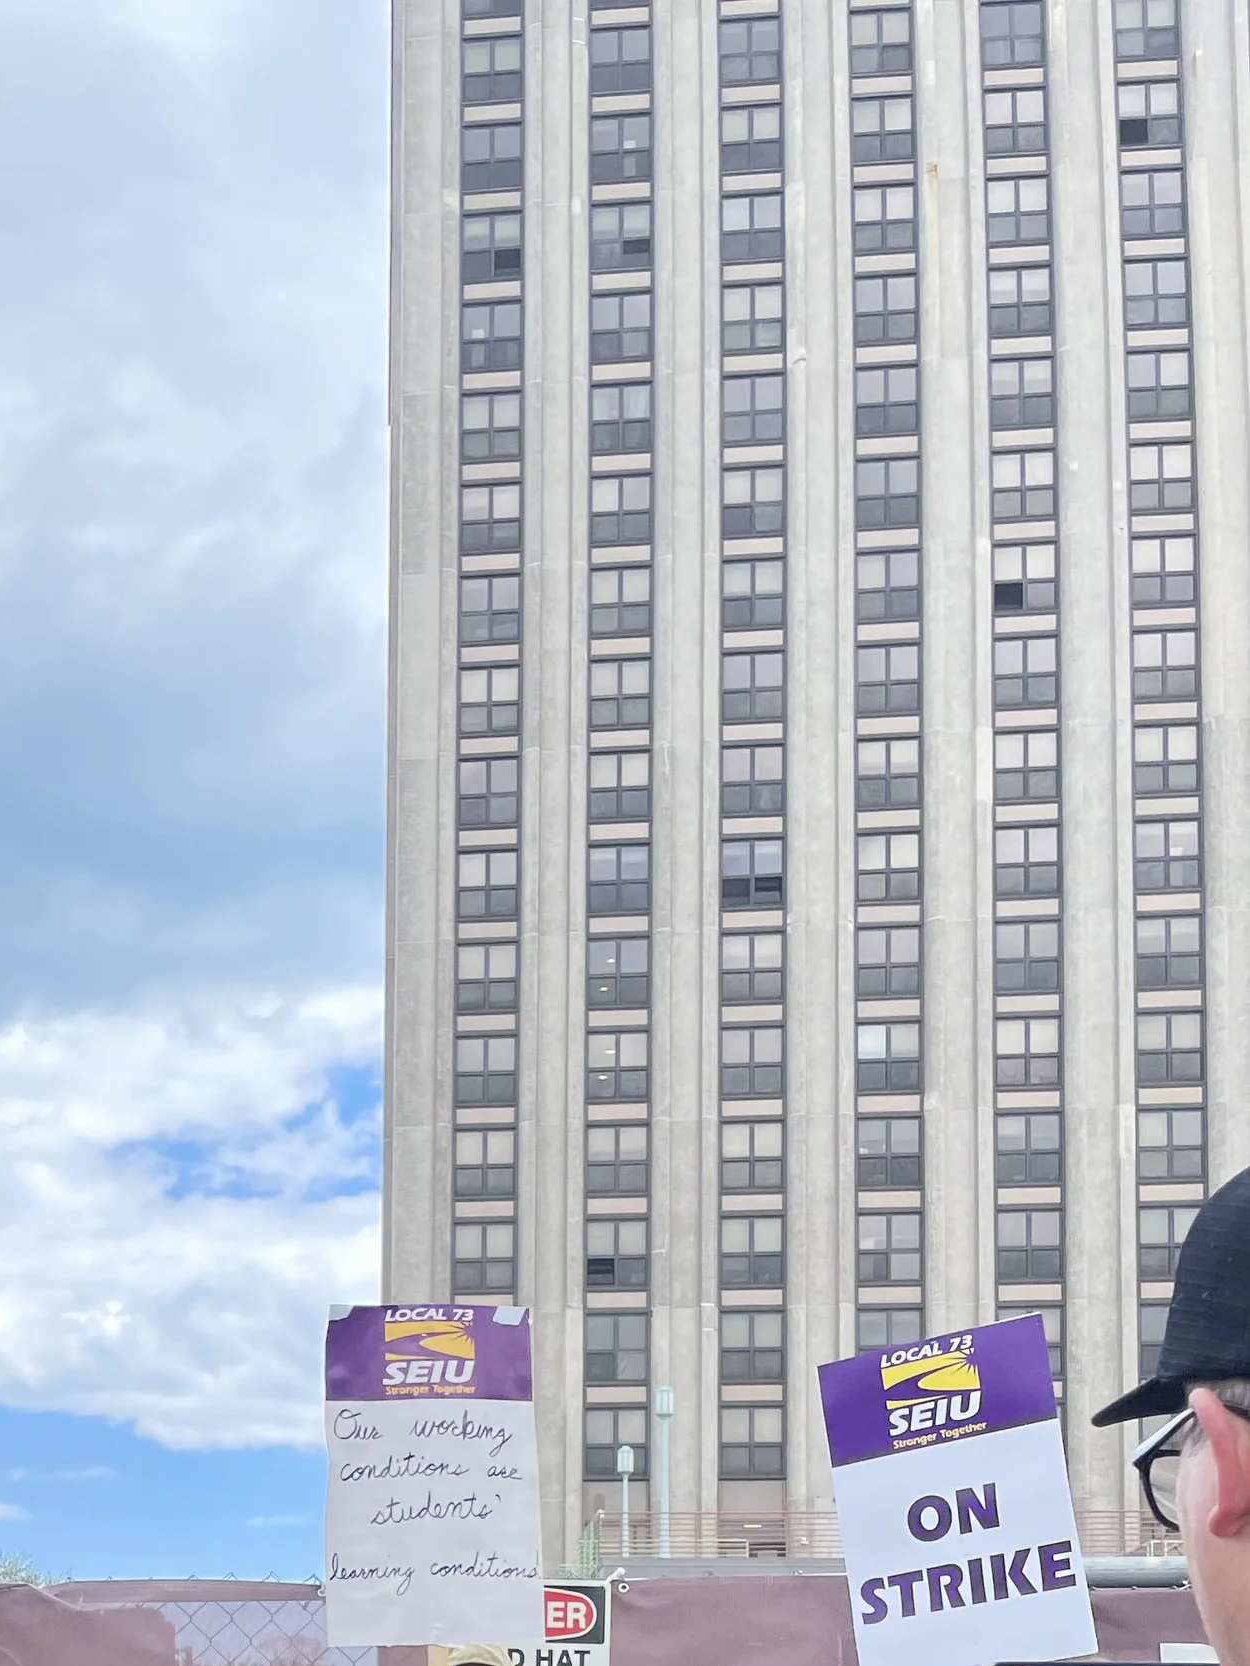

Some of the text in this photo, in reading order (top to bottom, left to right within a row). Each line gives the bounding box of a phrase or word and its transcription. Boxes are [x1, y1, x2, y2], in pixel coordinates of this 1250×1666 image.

[383, 1308, 474, 1322] LOCAL 73
[880, 1334, 974, 1369] LOCAL 73
[382, 1360, 476, 1386] SEIU
[385, 1384, 477, 1396] Stronger Together
[887, 1390, 982, 1437] SEIU
[334, 1409, 512, 1456] Our working
[892, 1421, 988, 1450] Stronger Together
[340, 1452, 522, 1482] conditions are
[907, 1482, 1000, 1542] ON
[330, 1552, 415, 1596] learning
[860, 1540, 1077, 1625] STRIKE
